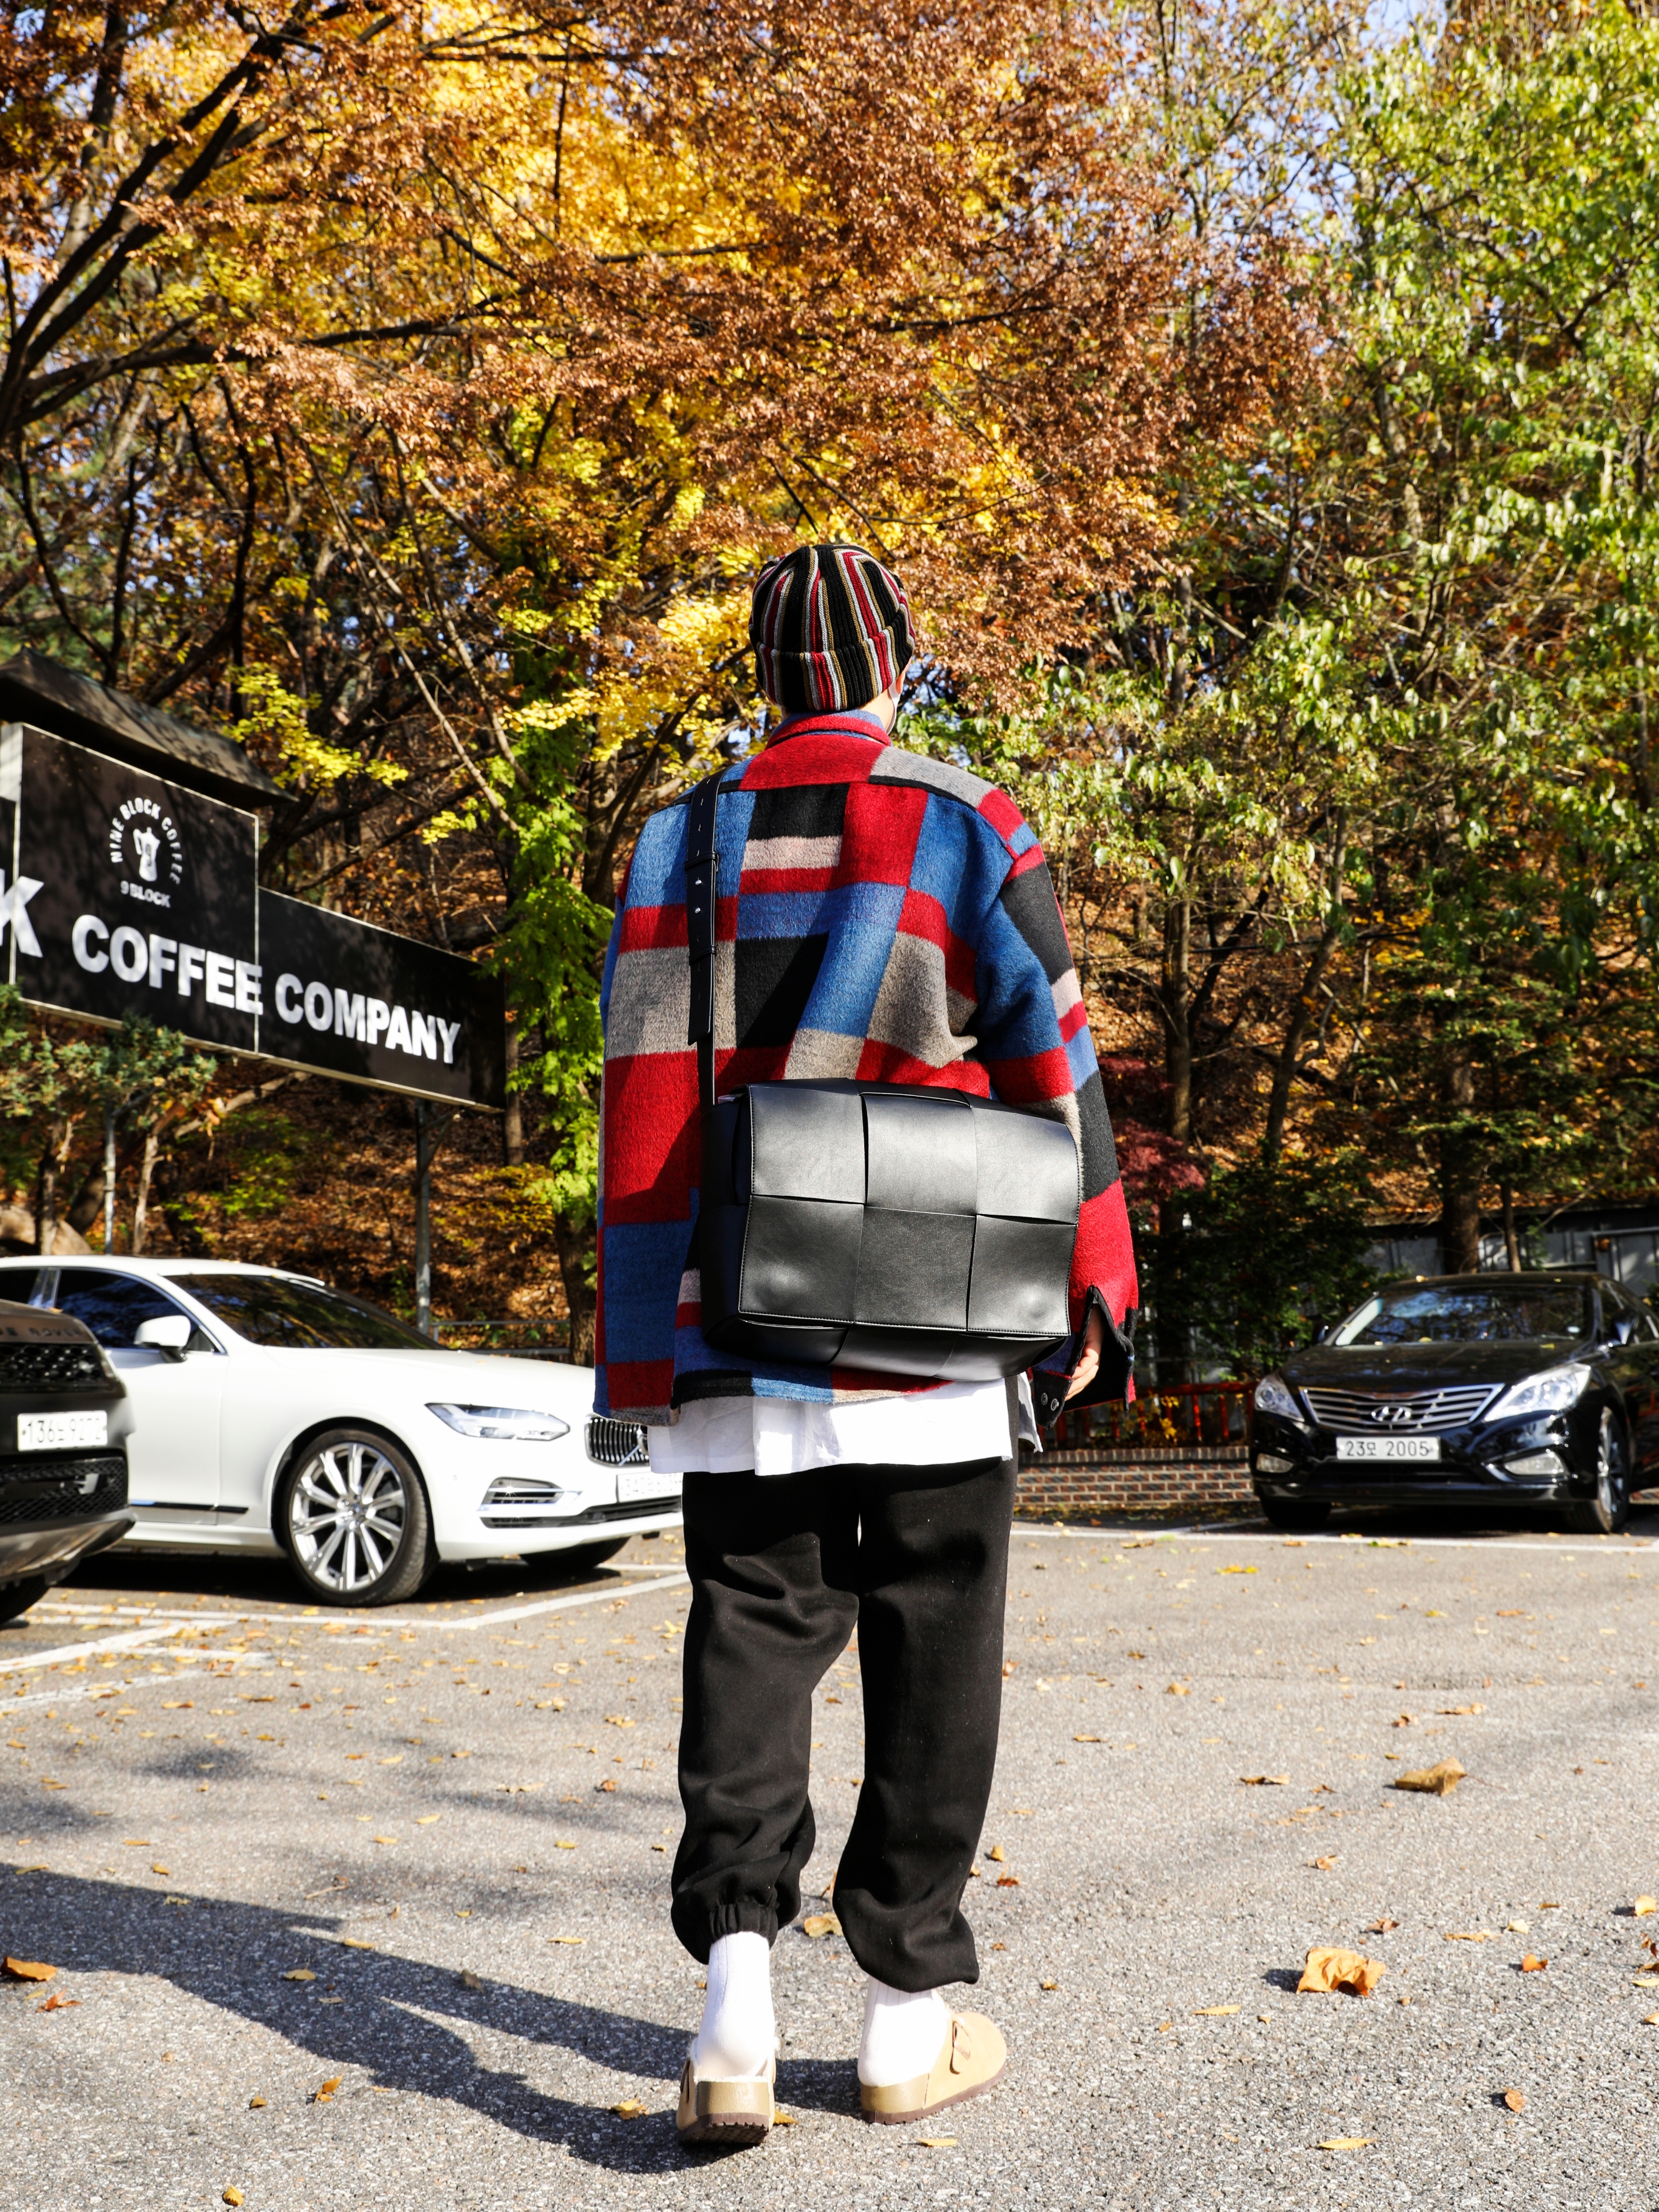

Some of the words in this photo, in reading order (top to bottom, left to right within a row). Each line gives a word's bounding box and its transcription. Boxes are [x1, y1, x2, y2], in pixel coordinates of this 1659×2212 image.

[109, 817, 125, 863] NINE
[119, 797, 161, 820] BLOCK
[161, 817, 182, 884] COFFEE
[120, 881, 129, 895] 9
[129, 883, 171, 908] BLOCK
[72, 914, 264, 1015] COFFEE
[275, 972, 461, 1064] COMPANY
[1387, 1441, 1428, 1457] 2005
